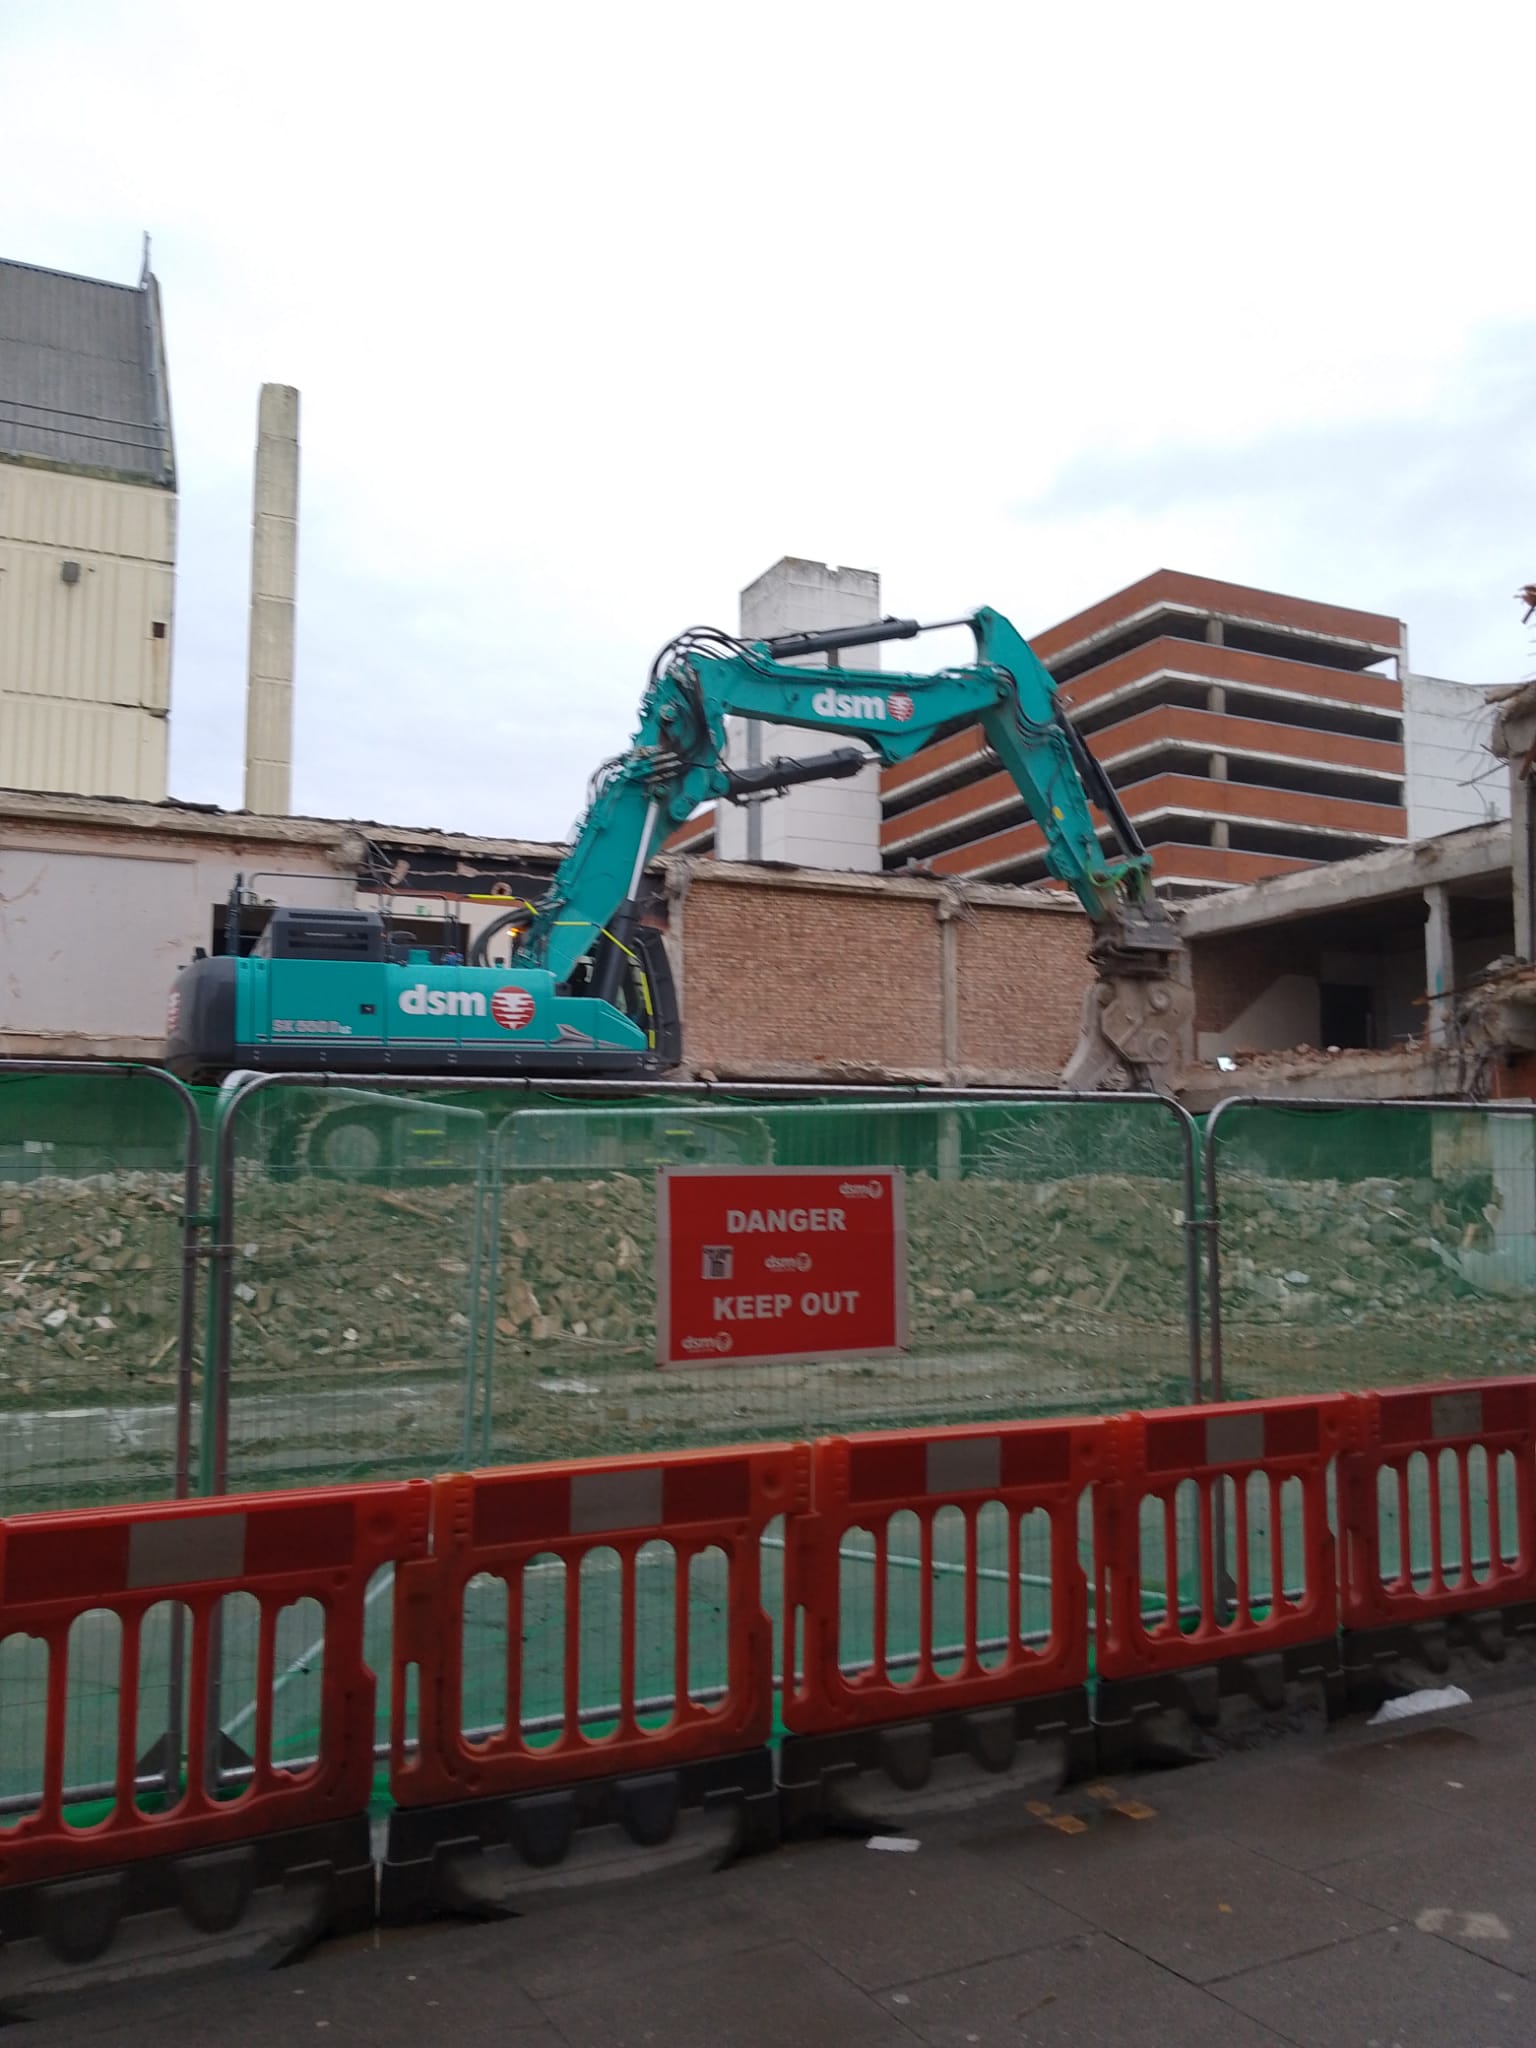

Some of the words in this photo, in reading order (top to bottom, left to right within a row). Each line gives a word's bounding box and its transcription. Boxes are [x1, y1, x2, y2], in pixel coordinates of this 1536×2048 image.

[812, 687, 886, 720] dsm
[398, 983, 487, 1016] dsm
[727, 1208, 847, 1233] DANGER
[713, 1294, 792, 1320] KEEP
[801, 1291, 859, 1315] OUT
